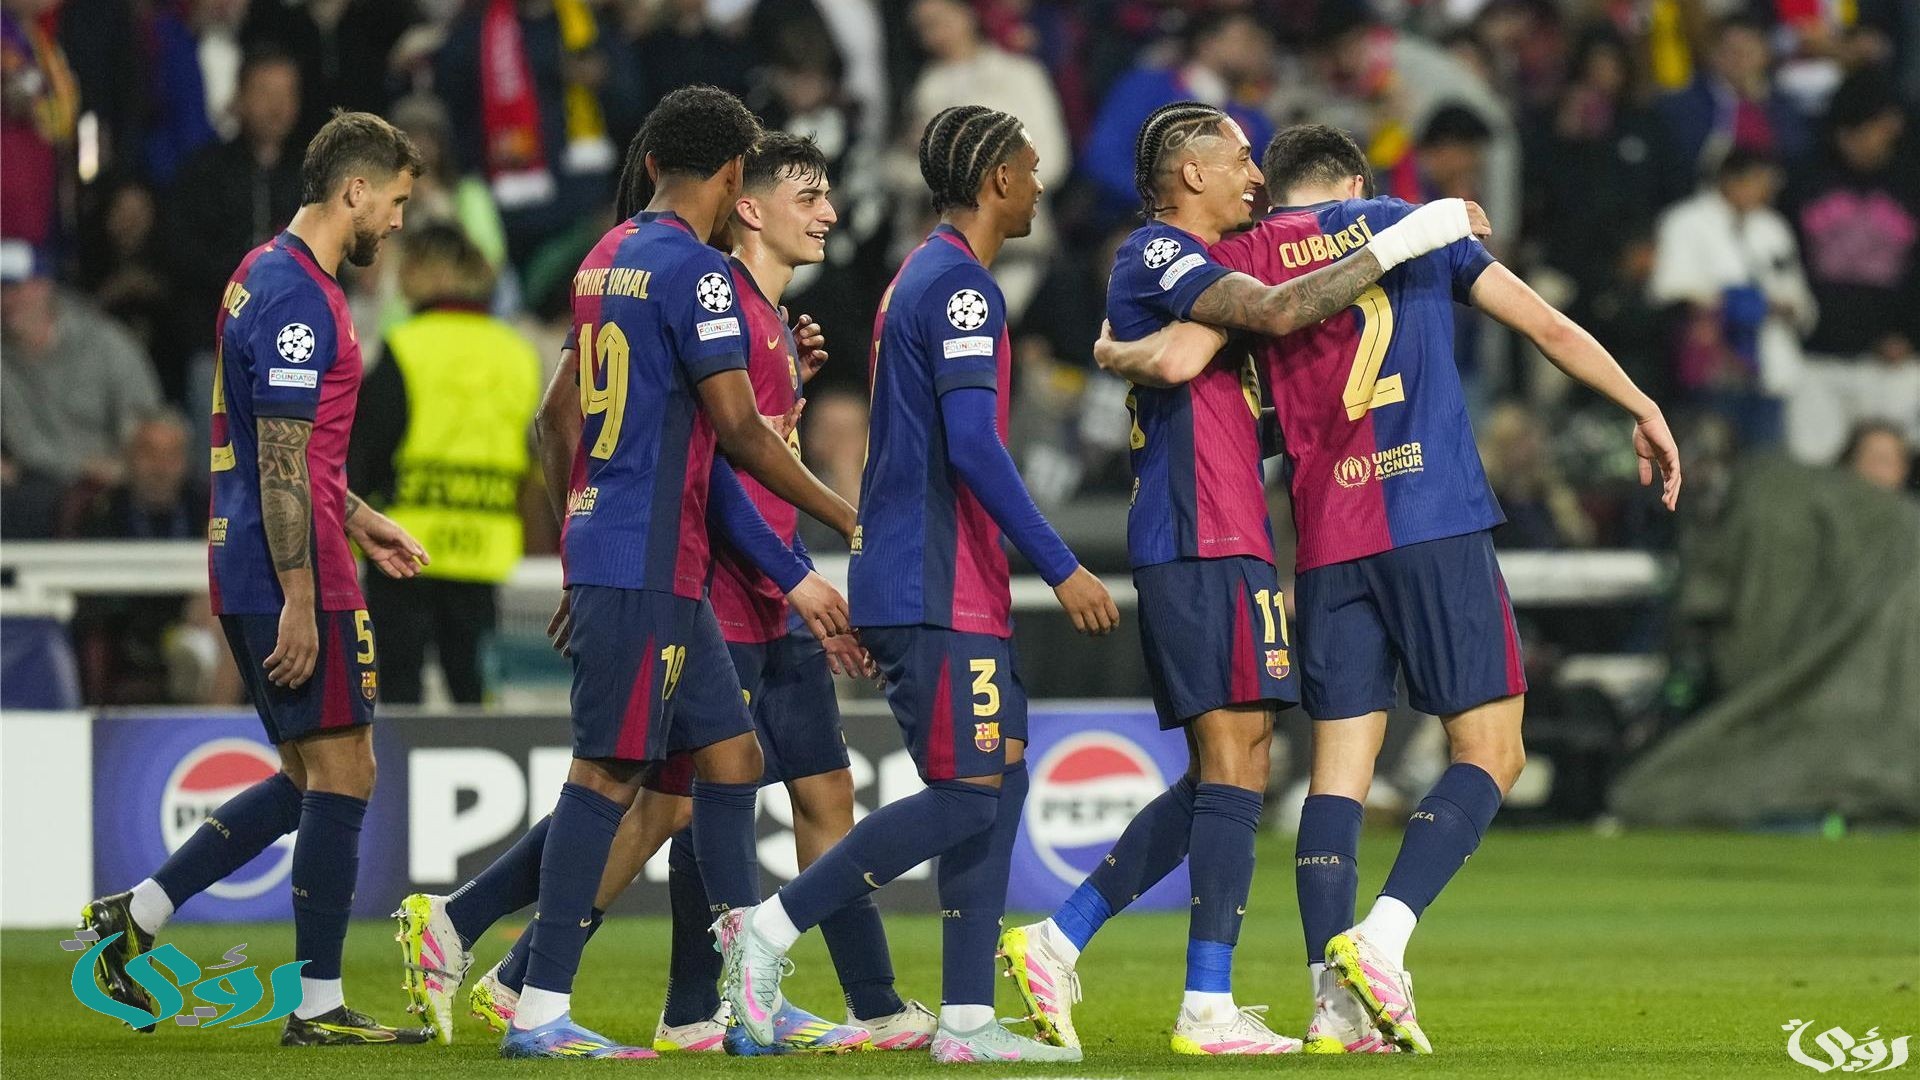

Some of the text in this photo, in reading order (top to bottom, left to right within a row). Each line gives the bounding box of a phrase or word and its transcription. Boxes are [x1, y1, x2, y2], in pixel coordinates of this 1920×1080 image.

[1278, 214, 1374, 269] CUBARSÍ
[607, 268, 652, 300] YAMAL
[1342, 281, 1406, 422] 2
[578, 321, 630, 461] 19
[1371, 442, 1422, 465] UNHCR
[1374, 454, 1424, 477] ACNUR
[354, 609, 375, 665] 5
[1254, 589, 1290, 648] 11
[661, 644, 686, 701] 19
[969, 658, 1001, 717] 3
